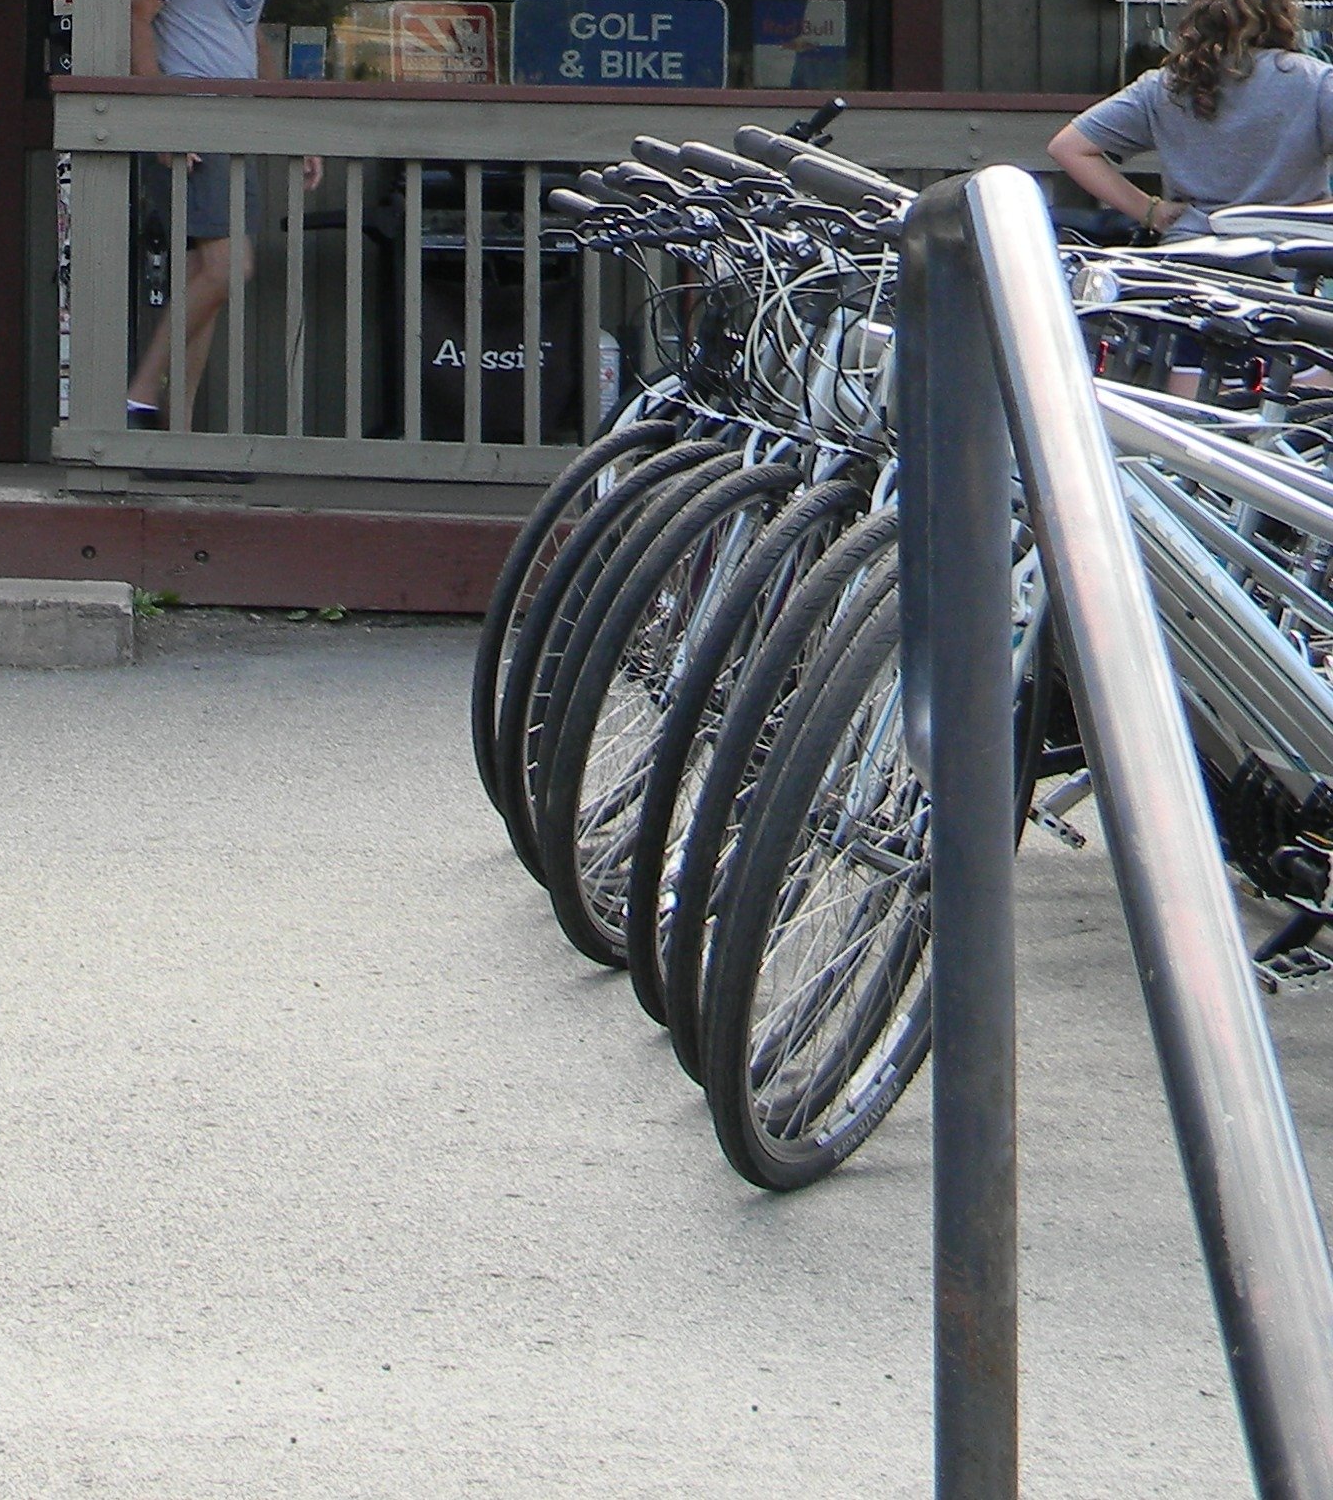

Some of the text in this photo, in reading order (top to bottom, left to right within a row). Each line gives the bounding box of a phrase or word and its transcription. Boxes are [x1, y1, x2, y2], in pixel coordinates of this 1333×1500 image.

[567, 11, 673, 42] GOLF
[558, 50, 684, 80] & BIKE
[432, 338, 545, 371] Assi
